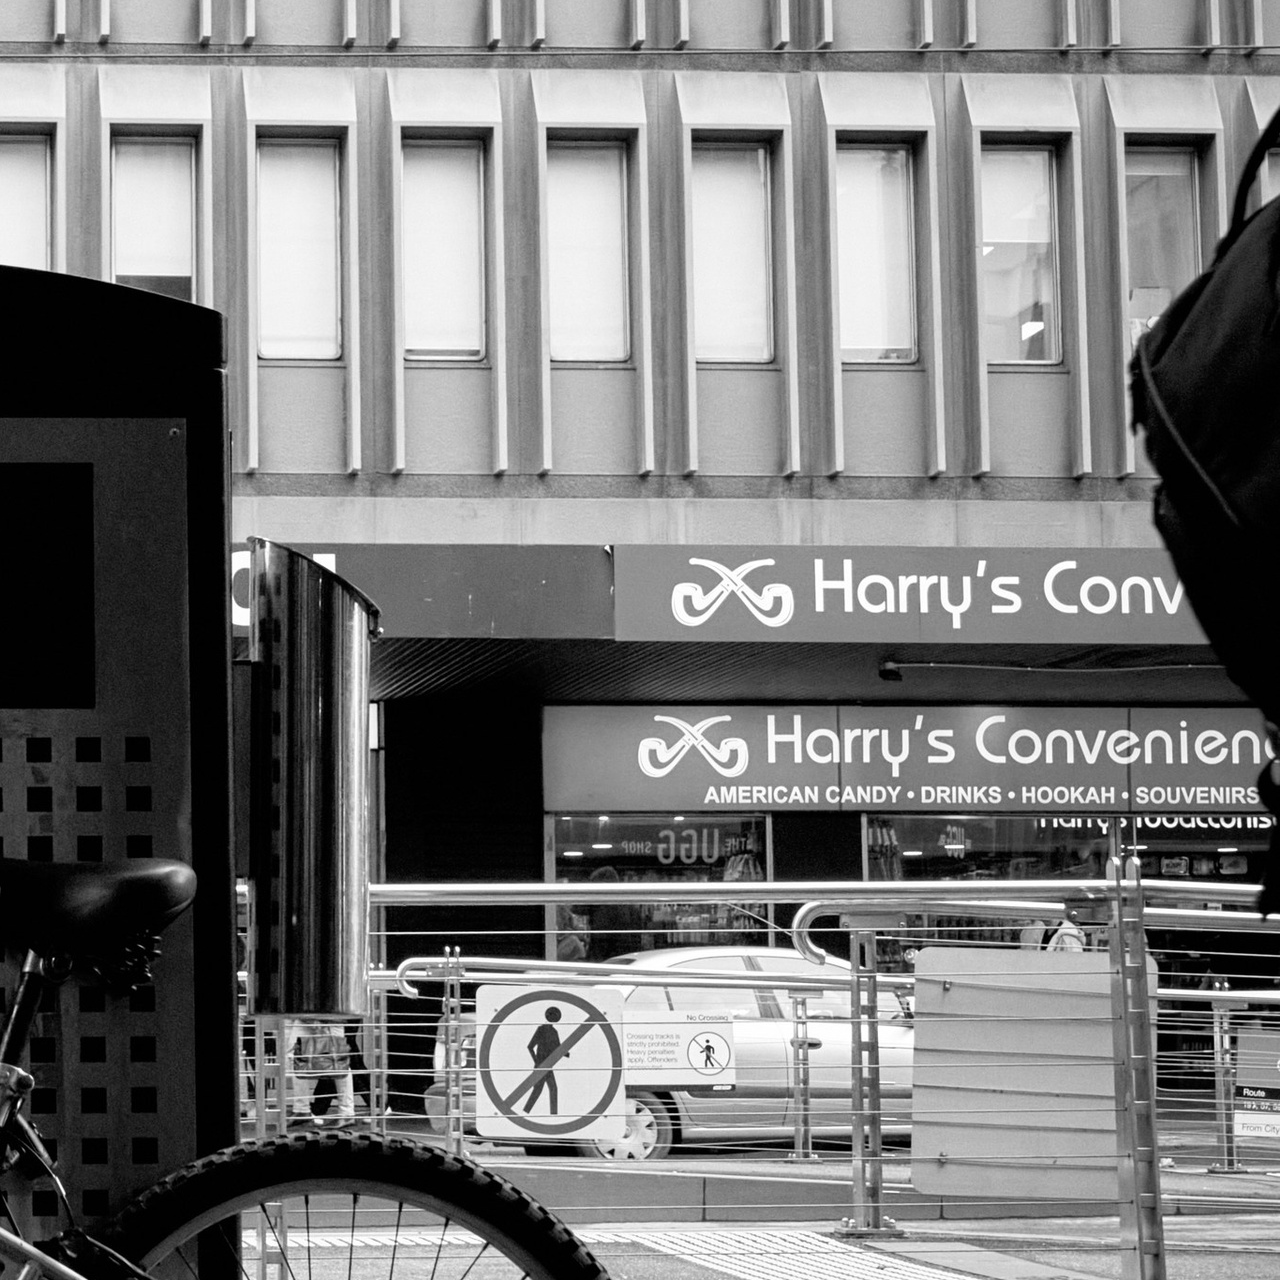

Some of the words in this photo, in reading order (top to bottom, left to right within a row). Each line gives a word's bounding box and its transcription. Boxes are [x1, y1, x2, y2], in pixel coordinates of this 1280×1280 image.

[814, 558, 1023, 630] Harry's
[766, 714, 956, 778] Harry's
[703, 785, 819, 804] AMERICAN
[825, 785, 902, 804] CANDY
[920, 785, 1002, 804] DRINKS
[1021, 786, 1115, 804] HOOKAH
[1135, 786, 1260, 804] SOUVENIRS
[698, 1014, 729, 1022] Crossing
[626, 1033, 655, 1041] Crossing
[626, 1041, 647, 1049] strictly
[1243, 1088, 1266, 1097] Route
[1242, 1123, 1262, 1132] From
[1264, 1124, 1280, 1135] City
